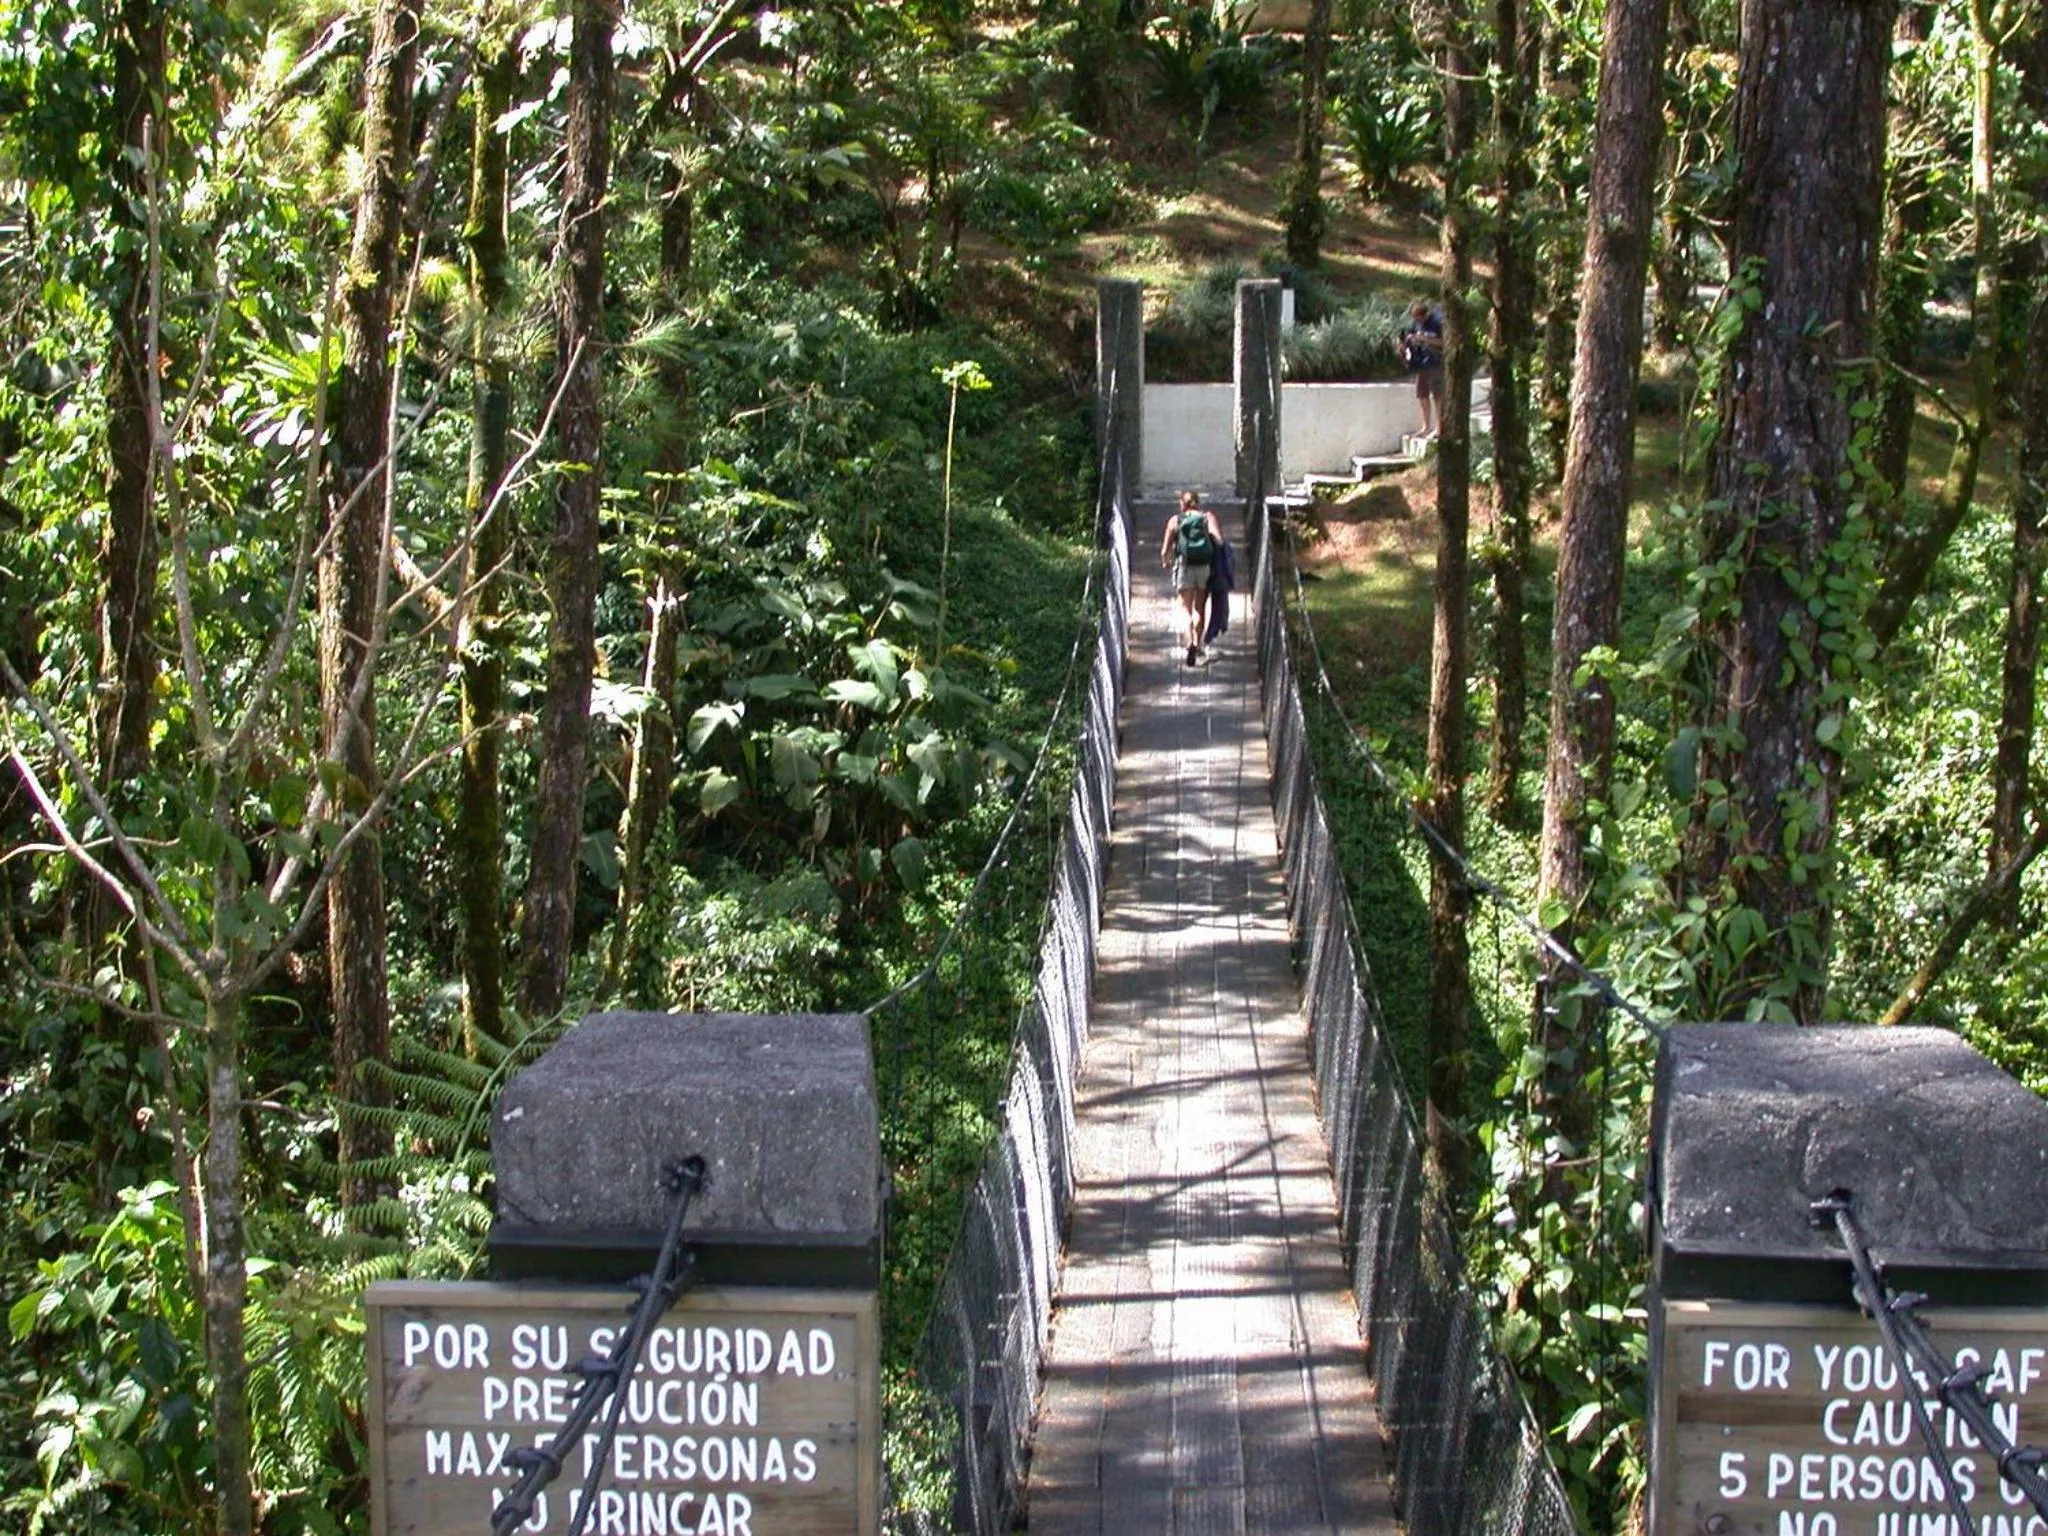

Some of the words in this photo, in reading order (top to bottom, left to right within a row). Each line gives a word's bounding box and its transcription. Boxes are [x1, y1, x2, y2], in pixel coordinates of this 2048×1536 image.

[403, 1322, 489, 1369] POR
[512, 1324, 568, 1371] SU
[589, 1327, 835, 1376] SGURIDAD
[1704, 1341, 1790, 1391] FOR
[1720, 1452, 1747, 1498] 5
[1768, 1452, 1976, 1503] PERSONS
